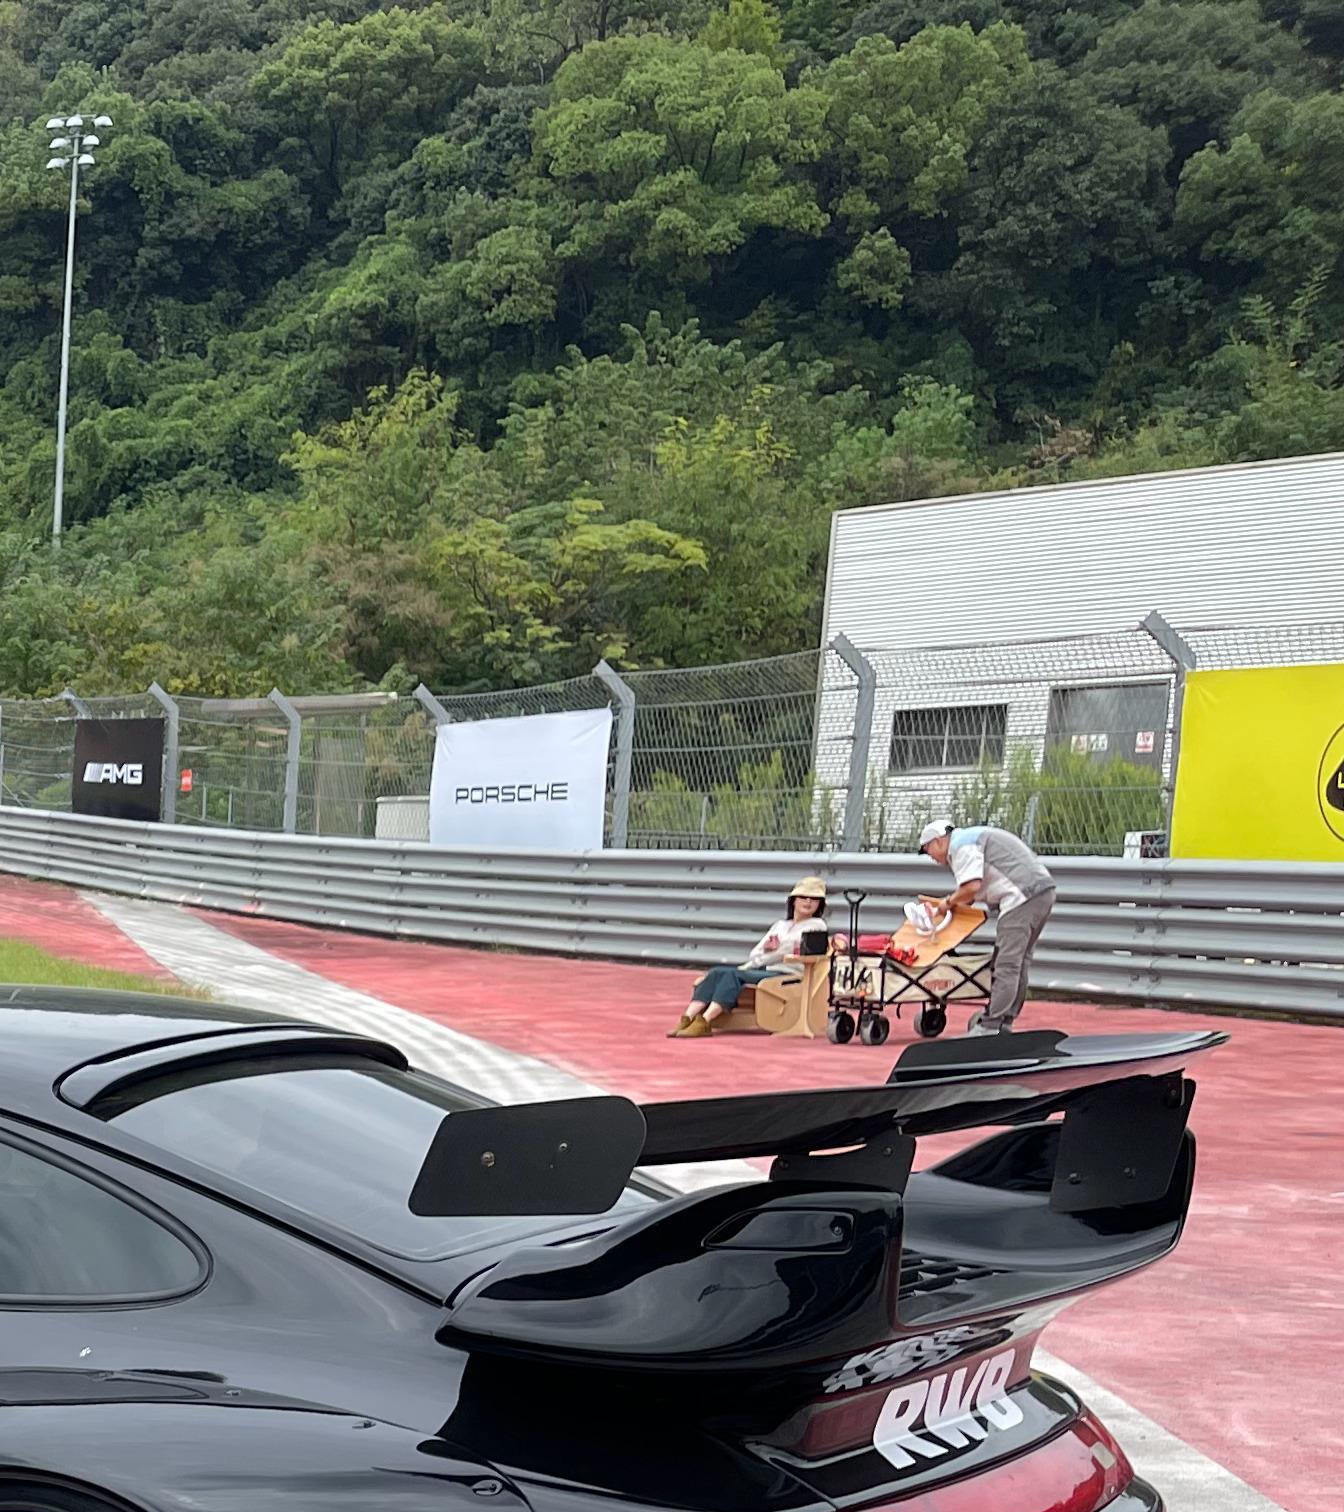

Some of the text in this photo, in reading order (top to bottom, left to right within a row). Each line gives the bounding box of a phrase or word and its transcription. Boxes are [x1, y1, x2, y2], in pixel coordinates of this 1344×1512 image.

[100, 763, 143, 785] AMG
[455, 782, 568, 804] PORSCHE
[872, 1348, 1024, 1470] RWB
